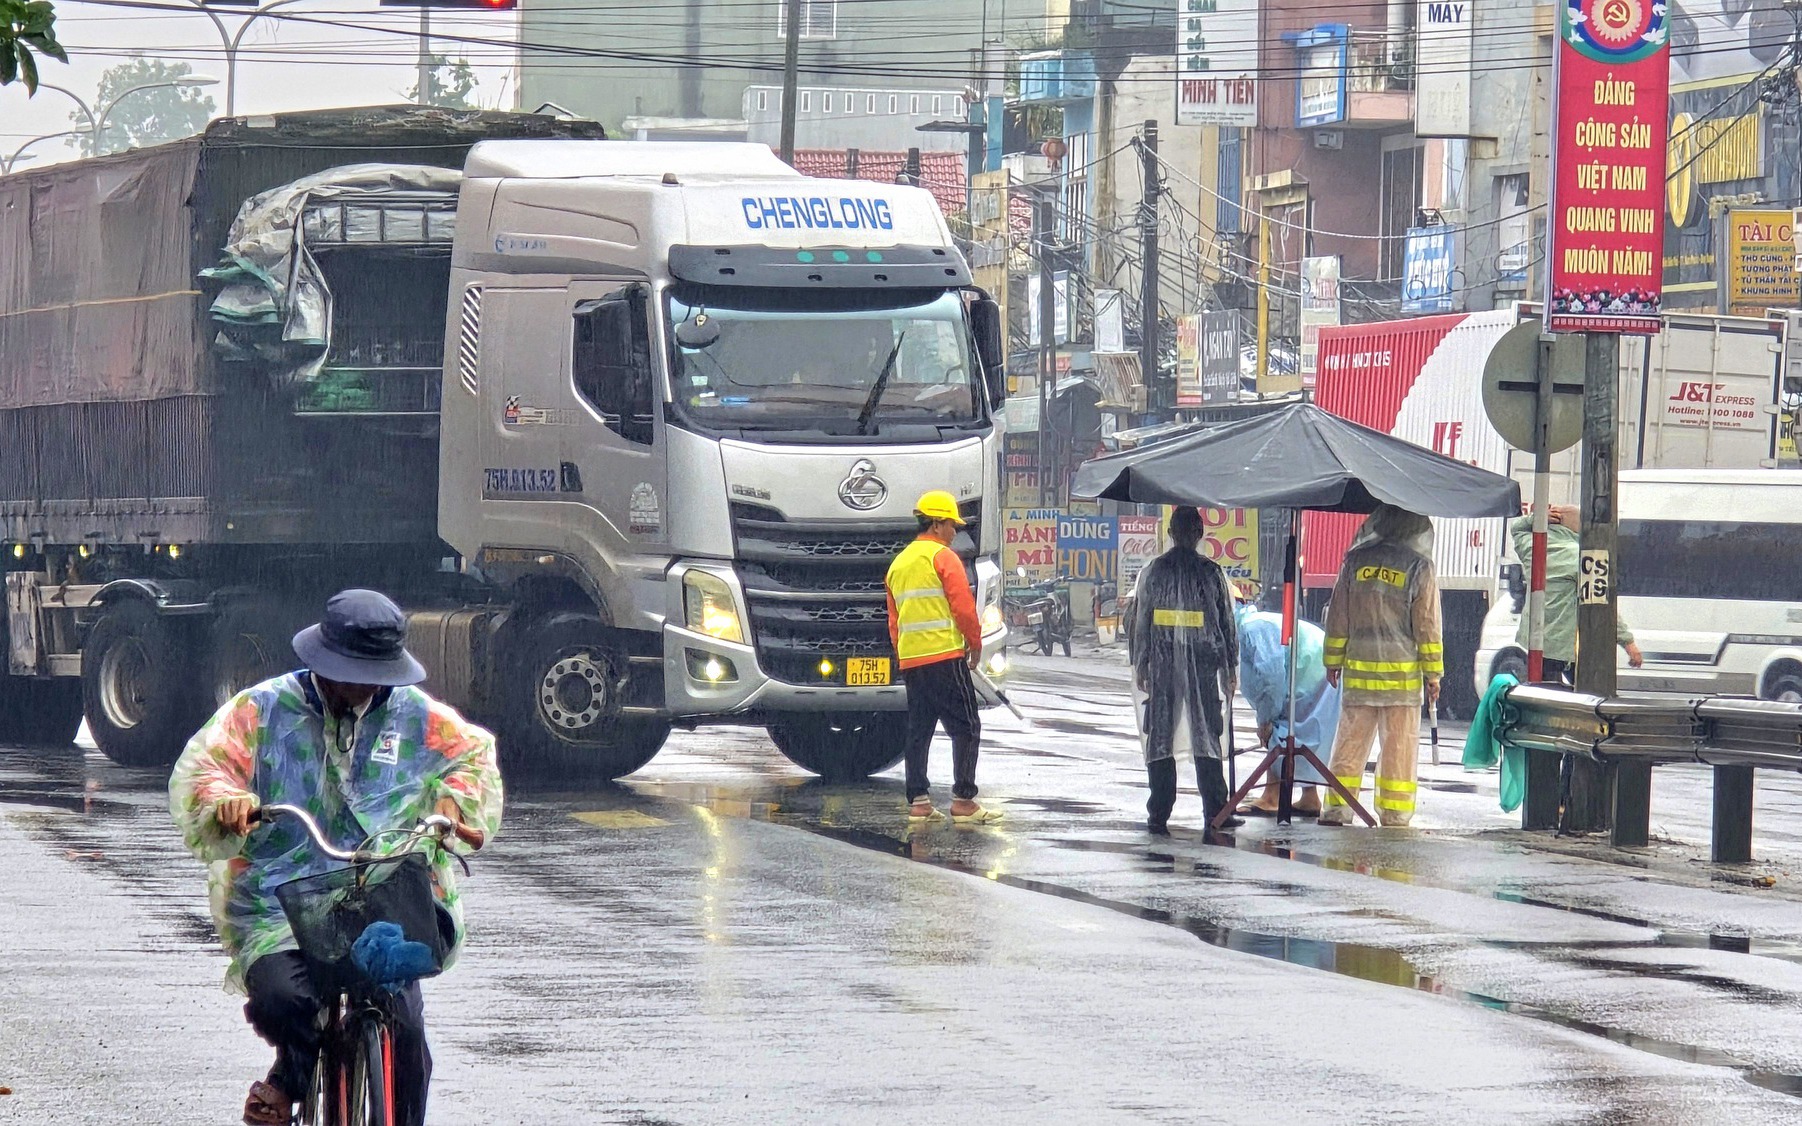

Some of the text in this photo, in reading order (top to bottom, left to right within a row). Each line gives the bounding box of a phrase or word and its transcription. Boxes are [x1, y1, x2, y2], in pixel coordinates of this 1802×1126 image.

[1182, 78, 1217, 103] MINH
[1594, 72, 1635, 105] ĐẢNG
[1575, 116, 1651, 152] CỘNG SẢN
[1577, 160, 1646, 194] VIỆT NAM
[741, 197, 893, 230] CHENGLONG
[1566, 206, 1655, 234] QUANG VINH
[1738, 220, 1794, 242] TÀI C
[1564, 244, 1609, 274] MUÔN
[1612, 245, 1653, 276] NĂM!
[1669, 381, 1755, 406] J&T EXPRESS
[1667, 406, 1705, 416] Hotline:
[1732, 410, 1754, 419] 1088
[1680, 418, 1742, 428] www.jtepress.vn
[1060, 517, 1111, 539] DŨNG
[1121, 520, 1154, 532] TIẾNG
[1017, 544, 1056, 566] MÌ
[1581, 556, 1608, 577] CS
[1582, 578, 1608, 600] 19
[860, 659, 878, 671] 75H
[851, 672, 886, 684] 013.52
